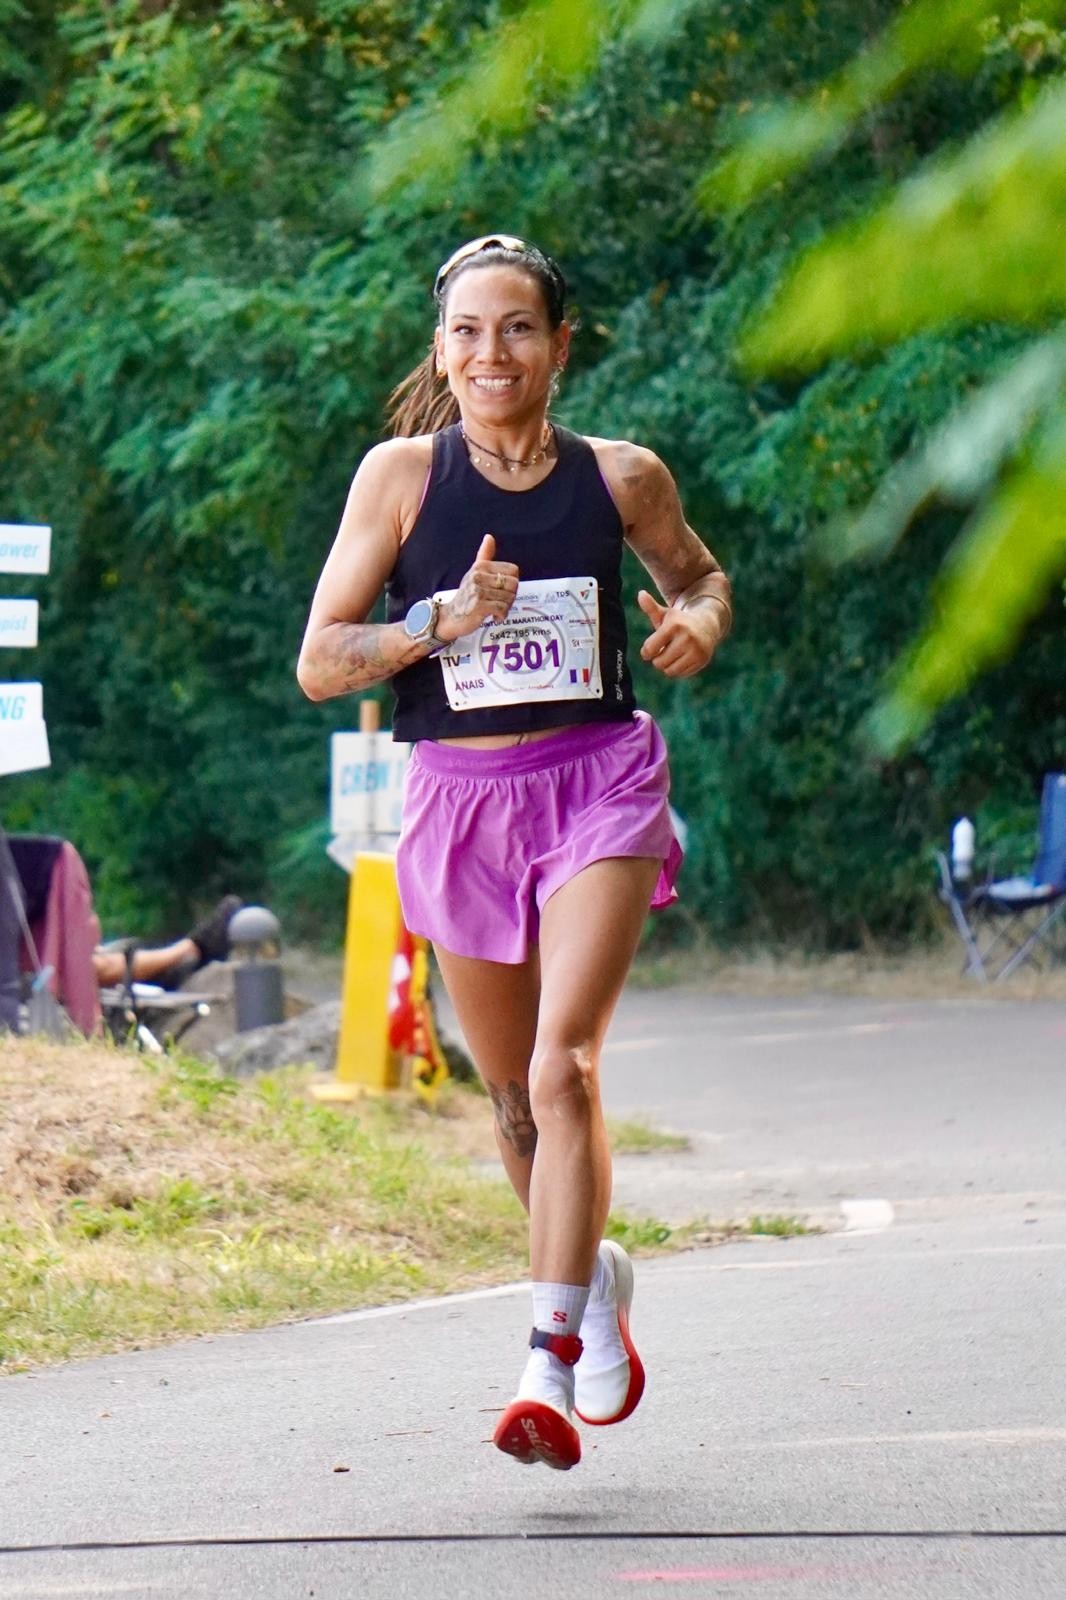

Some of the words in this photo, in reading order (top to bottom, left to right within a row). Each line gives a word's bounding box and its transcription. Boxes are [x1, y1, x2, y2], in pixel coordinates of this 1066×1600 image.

[512, 615, 549, 624] MARATHON
[481, 639, 560, 673] 7501
[455, 679, 485, 692] ANAIS
[553, 1311, 567, 1323] S
